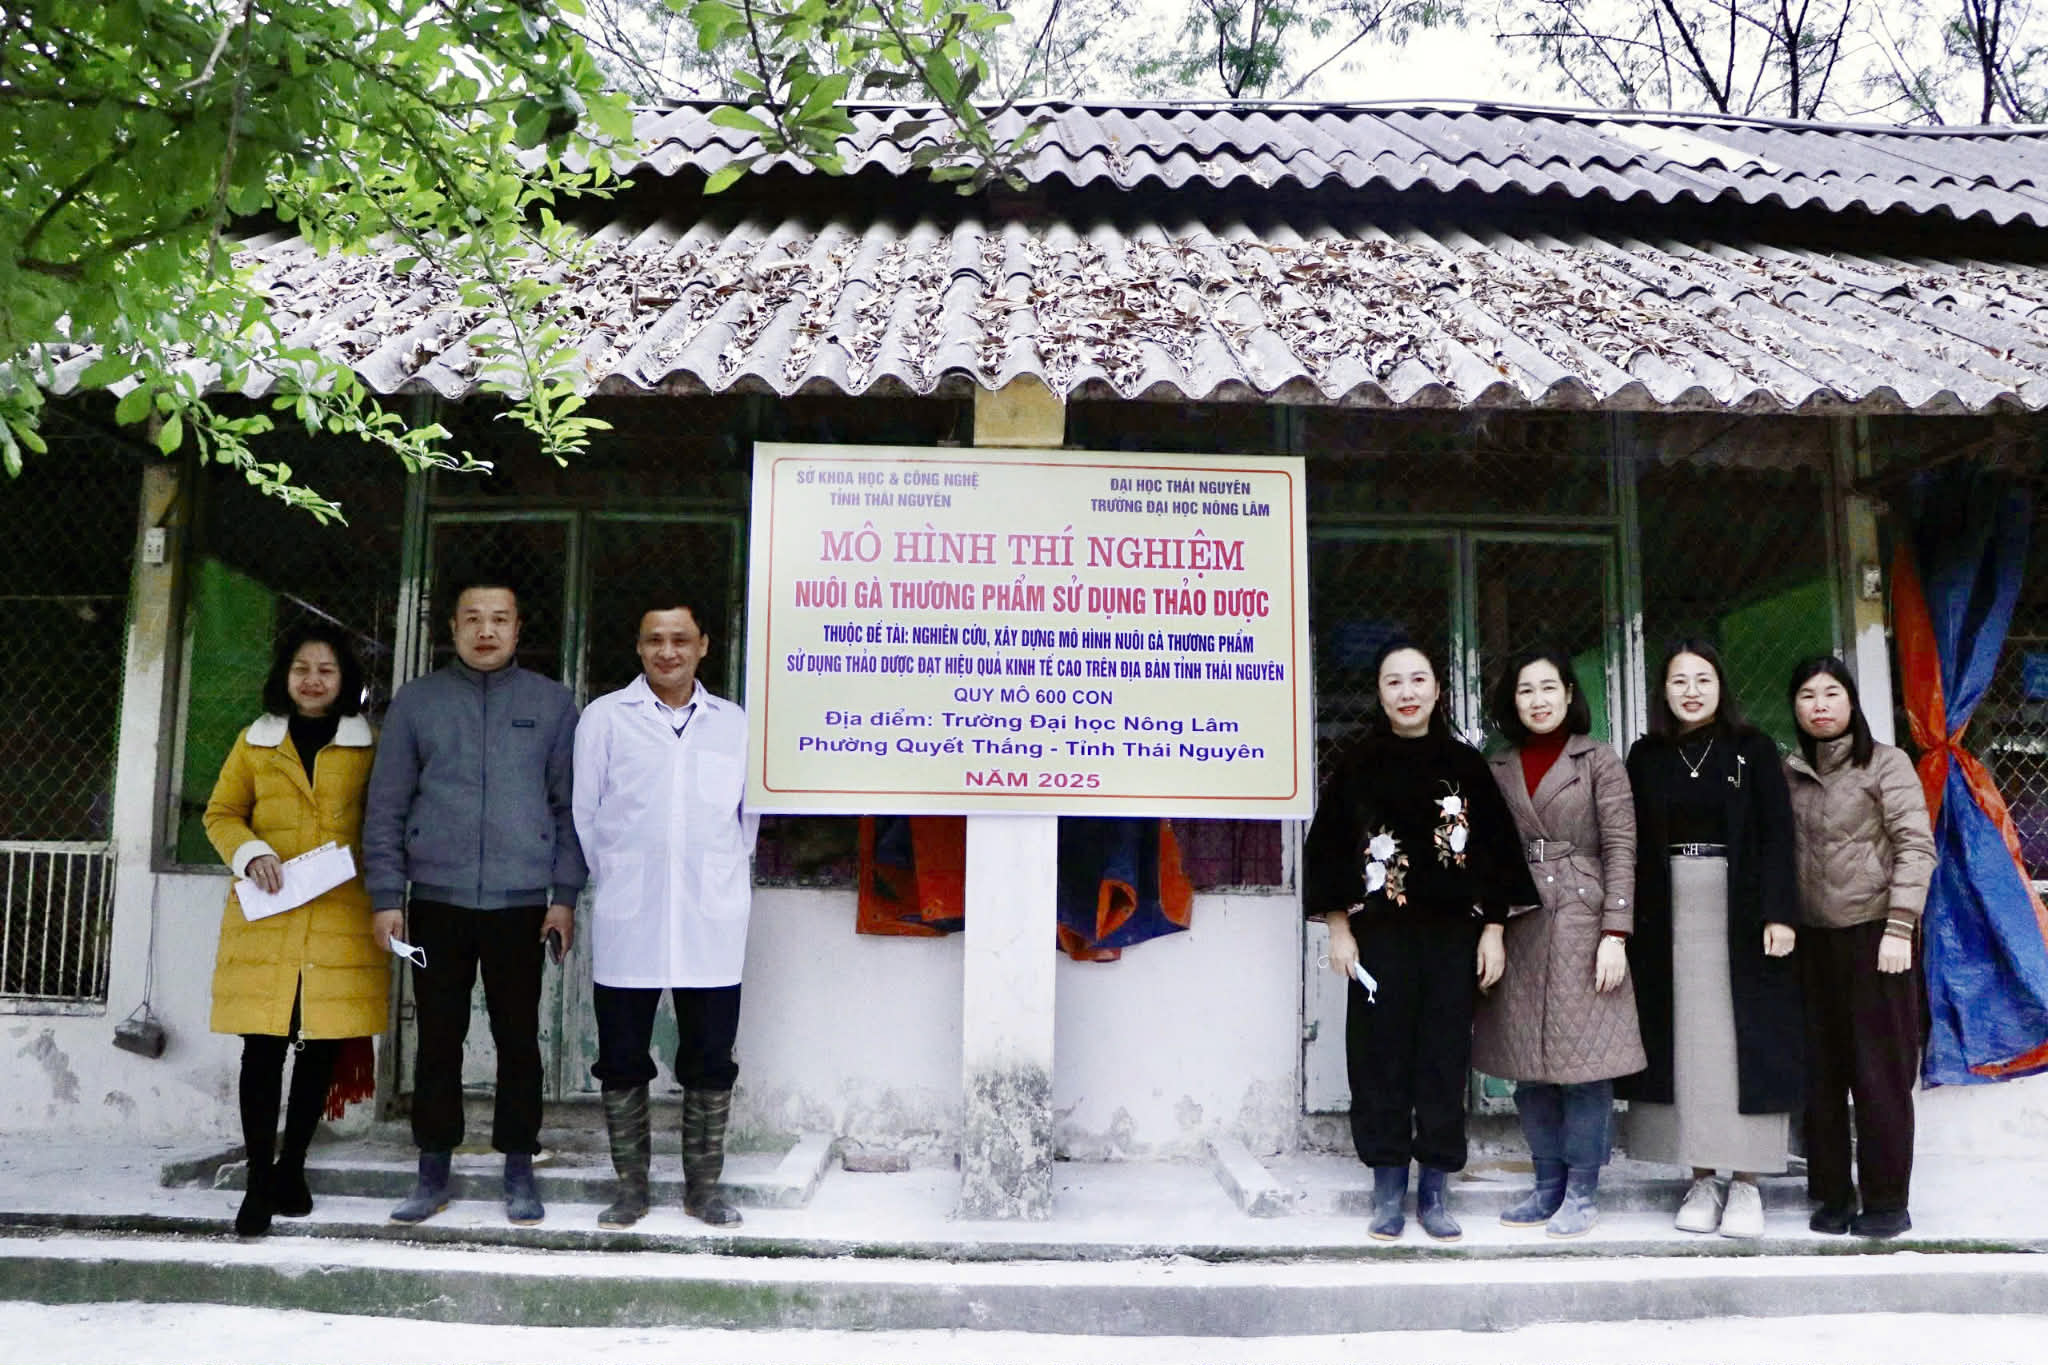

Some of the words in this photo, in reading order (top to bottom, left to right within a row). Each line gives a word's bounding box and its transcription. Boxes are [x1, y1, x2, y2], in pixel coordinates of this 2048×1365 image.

[819, 471, 854, 484] KHOA
[858, 472, 884, 488] HỌC
[890, 473, 900, 485] &
[904, 469, 940, 486] CÔNG
[944, 472, 979, 490] NGHỆ
[1111, 479, 1132, 494] ĐẠI
[1137, 479, 1162, 495] HỌC
[1166, 477, 1194, 493] THÁI
[1199, 480, 1251, 495] NGUYÊN
[865, 491, 894, 506] THÁI
[898, 493, 952, 508] NGUYÊN
[1091, 497, 1142, 512] TRƯỜNG
[1147, 501, 1168, 516] ĐẠI
[1173, 502, 1198, 517] HỌC
[1202, 502, 1238, 516] NÔNG
[1243, 502, 1270, 516] LÂM
[820, 521, 882, 562] MÔ
[893, 523, 997, 564] HÌNH
[1008, 525, 1074, 565] THÍ
[1087, 529, 1245, 578] NGHIỆM
[795, 576, 846, 608] NUÔI
[855, 576, 883, 608] GÀ
[890, 580, 975, 610] THƯƠNG
[982, 574, 1044, 611] PHẨM
[1053, 575, 1083, 613] SỬ
[1088, 587, 1146, 620] DỤNG
[1153, 577, 1206, 615] THẢO
[1214, 588, 1269, 623] DƯỢC
[824, 622, 862, 646] THUỘC
[913, 624, 958, 644] NGHIÊN
[962, 624, 990, 647] CỨU,
[995, 626, 1016, 646] XÂY
[1022, 629, 1055, 650] DỰNG
[1059, 628, 1077, 648] MÔ
[1082, 628, 1111, 649] HÌNH
[1116, 630, 1144, 650] NUÔI
[1149, 630, 1164, 651] GÀ
[1168, 633, 1215, 652] THƯƠNG
[1219, 629, 1254, 653] PHẨM
[787, 648, 804, 672] SỬ
[808, 655, 842, 676] DỤNG
[846, 649, 876, 673] THẢO
[881, 655, 914, 677] DƯỢC
[918, 656, 941, 677] ĐẠT
[945, 654, 973, 678] HIỆU
[977, 651, 1001, 676] QUẢ
[1006, 658, 1035, 676] KINH
[1039, 653, 1054, 676] TẾ
[1058, 660, 1082, 677] CAO
[1086, 657, 1117, 678] TRÊN
[1121, 662, 1141, 681] ĐỊA
[1145, 659, 1170, 678] BÀN
[1174, 657, 1201, 679] TỈNH
[1205, 660, 1232, 680] THÁI
[1236, 661, 1284, 680] NGUYÊN
[954, 687, 994, 702] QUY
[1001, 686, 1030, 703] MÔ
[1036, 690, 1066, 704] 600
[1073, 690, 1113, 704] CON
[825, 711, 862, 728] Địa
[871, 708, 933, 726] điểm:
[942, 712, 1022, 731] Trường
[1030, 715, 1066, 732] Đại
[1075, 716, 1116, 733] học
[1124, 716, 1183, 735] Nông
[1192, 718, 1239, 732] Lâm
[799, 737, 888, 755] Phường
[896, 736, 964, 756] Quyết
[972, 737, 1042, 758] Thắng
[1066, 740, 1115, 756] Tỉnh
[1123, 742, 1170, 757] Thái
[1180, 744, 1264, 761] Nguyên
[966, 769, 1028, 787] NĂM
[1038, 773, 1100, 788] 2025
